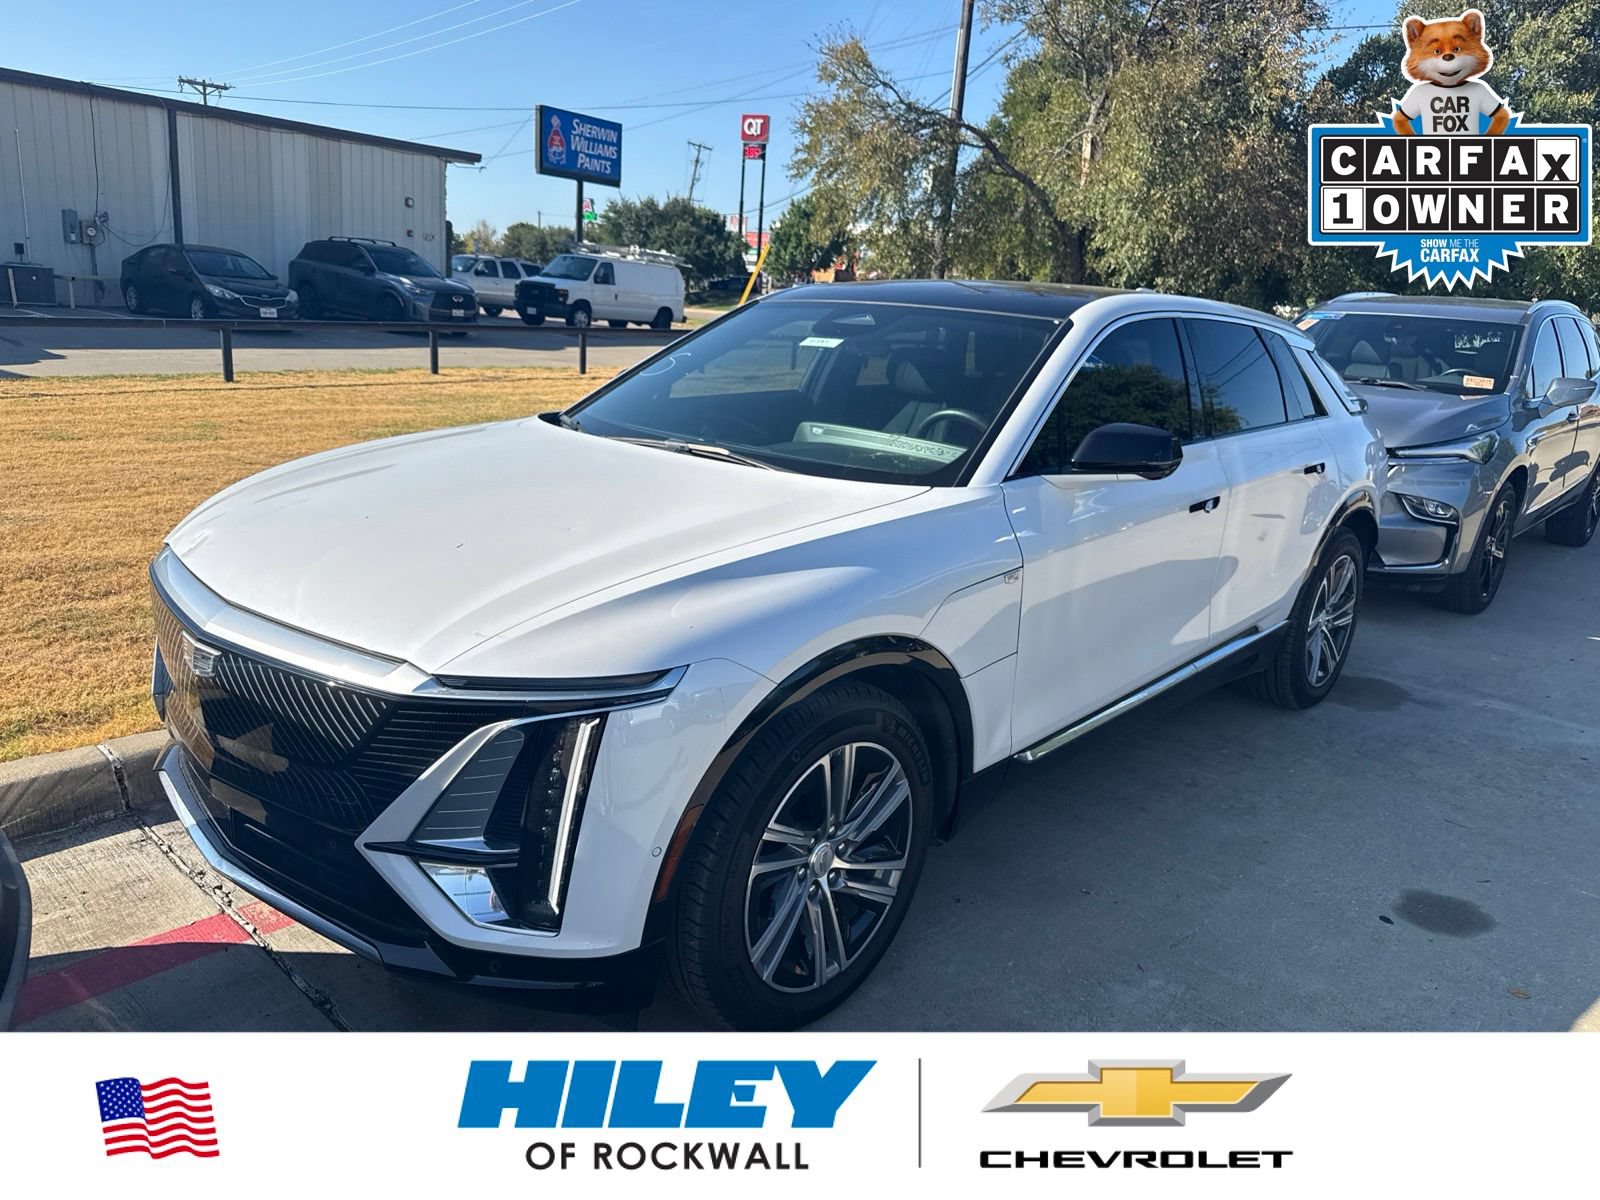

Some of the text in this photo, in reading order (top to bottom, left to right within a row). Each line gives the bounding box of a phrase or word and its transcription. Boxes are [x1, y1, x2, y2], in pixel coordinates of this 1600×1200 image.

[571, 118, 618, 143] SHERWIN
[743, 118, 764, 136] QT
[570, 134, 618, 159] WILLIAMS
[577, 153, 612, 174] PAINTS
